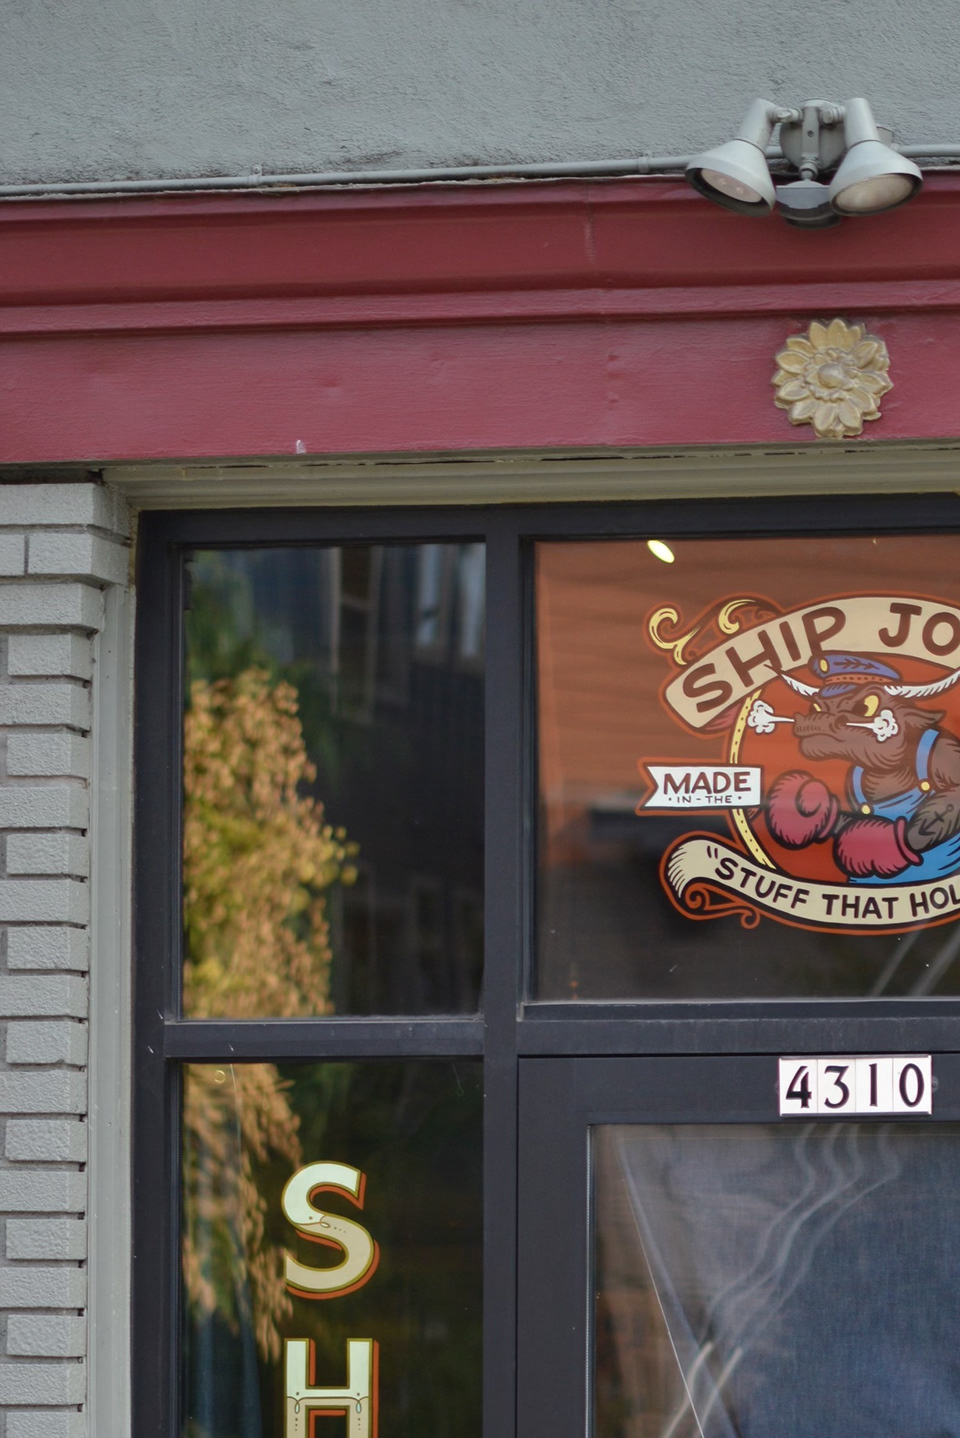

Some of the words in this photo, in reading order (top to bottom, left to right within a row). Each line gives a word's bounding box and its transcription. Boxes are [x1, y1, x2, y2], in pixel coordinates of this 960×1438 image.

[682, 606, 847, 713] SHIP
[663, 771, 752, 795] MADE
[821, 893, 899, 920] THAT
[785, 1062, 925, 1109] 4310
